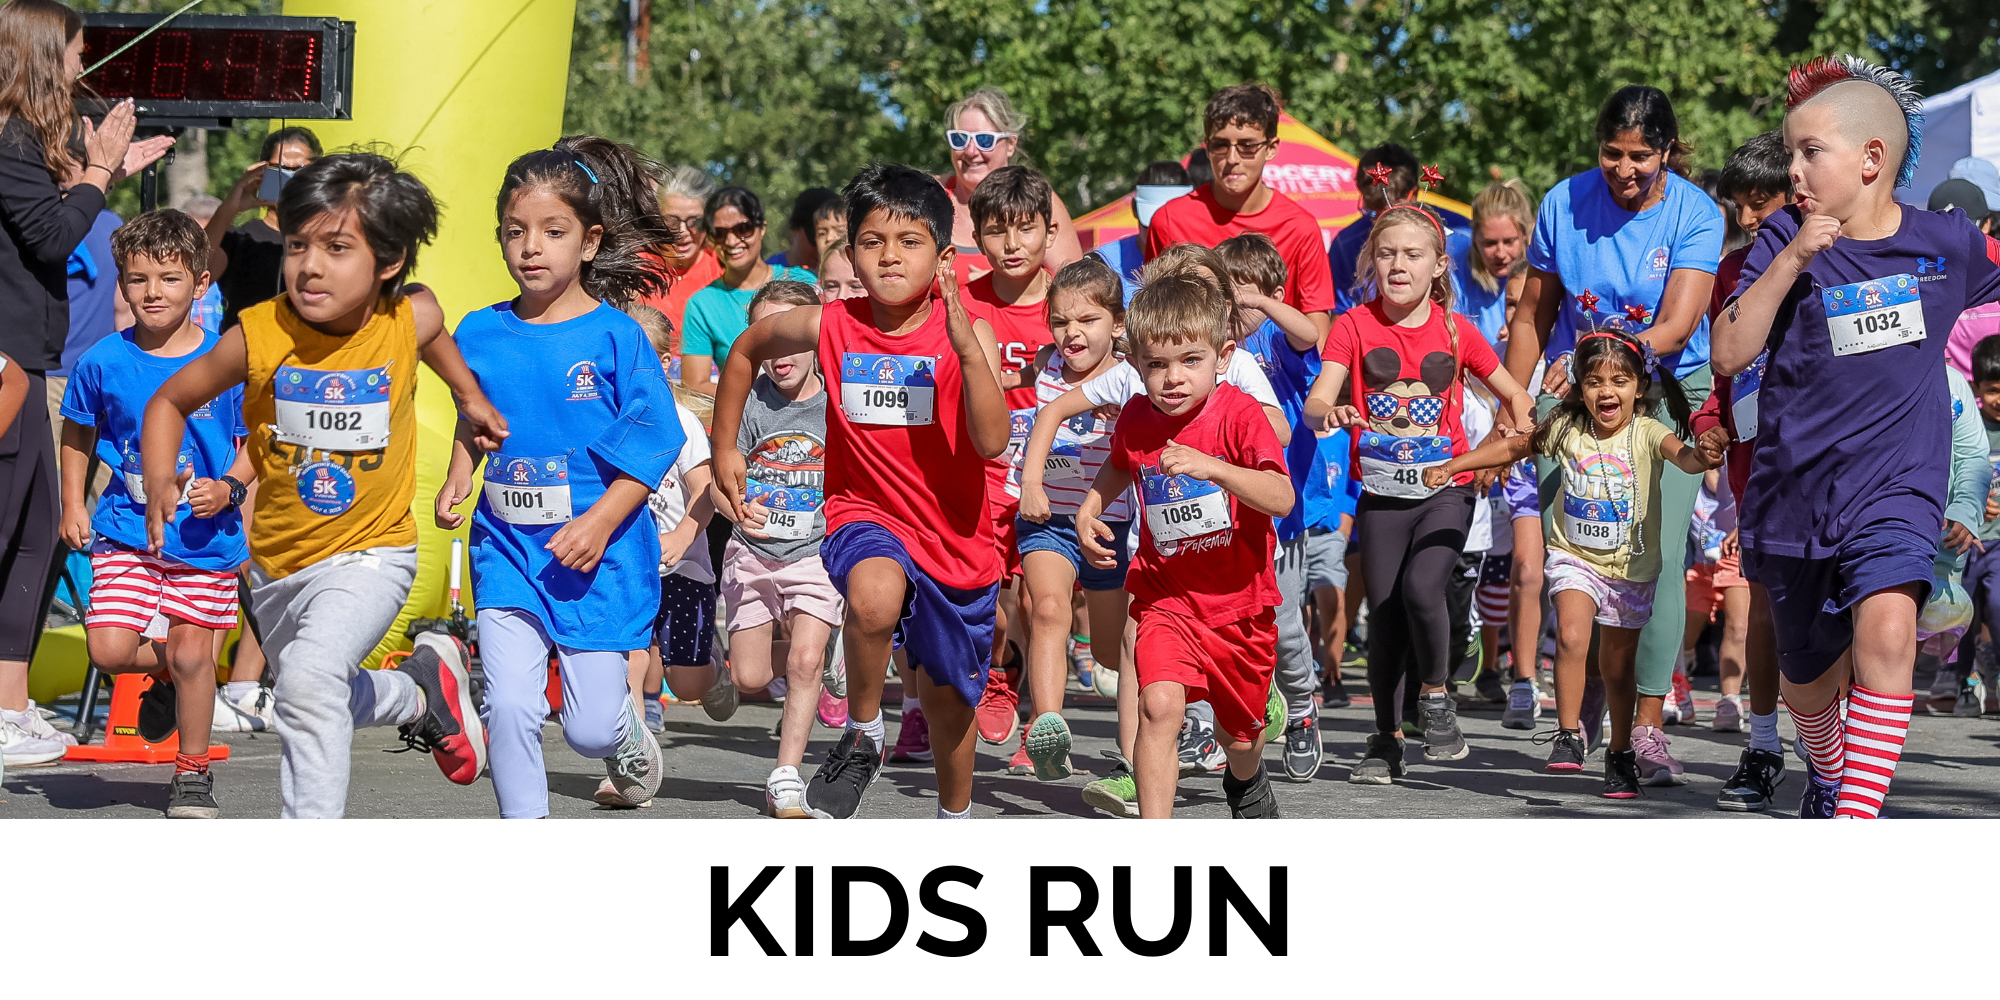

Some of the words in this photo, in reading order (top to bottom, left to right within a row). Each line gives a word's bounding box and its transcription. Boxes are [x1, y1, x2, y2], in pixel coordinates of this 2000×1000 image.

[1262, 164, 1353, 183] OCERY
[1263, 179, 1341, 194] UTLET
[1652, 257, 1668, 268] 5K
[1865, 292, 1883, 306] 5K
[1853, 311, 1901, 335] 1032
[576, 374, 595, 386] 5K
[878, 369, 896, 381] 5K
[324, 386, 347, 400] 5K
[863, 389, 909, 409] 1099
[305, 410, 362, 431] 1082
[1012, 423, 1029, 433] 5K
[1397, 449, 1415, 460] 5K
[513, 470, 530, 482] 5K
[1393, 468, 1418, 485] 48
[312, 479, 339, 495] 5K
[1168, 485, 1184, 498] 5K
[1563, 468, 1623, 500] CUTE
[502, 490, 543, 508] 1001
[774, 497, 788, 507] 5K
[769, 512, 796, 527] 045
[1161, 503, 1203, 525] 1085
[1586, 509, 1600, 519] 5K
[1576, 522, 1610, 538] 1038
